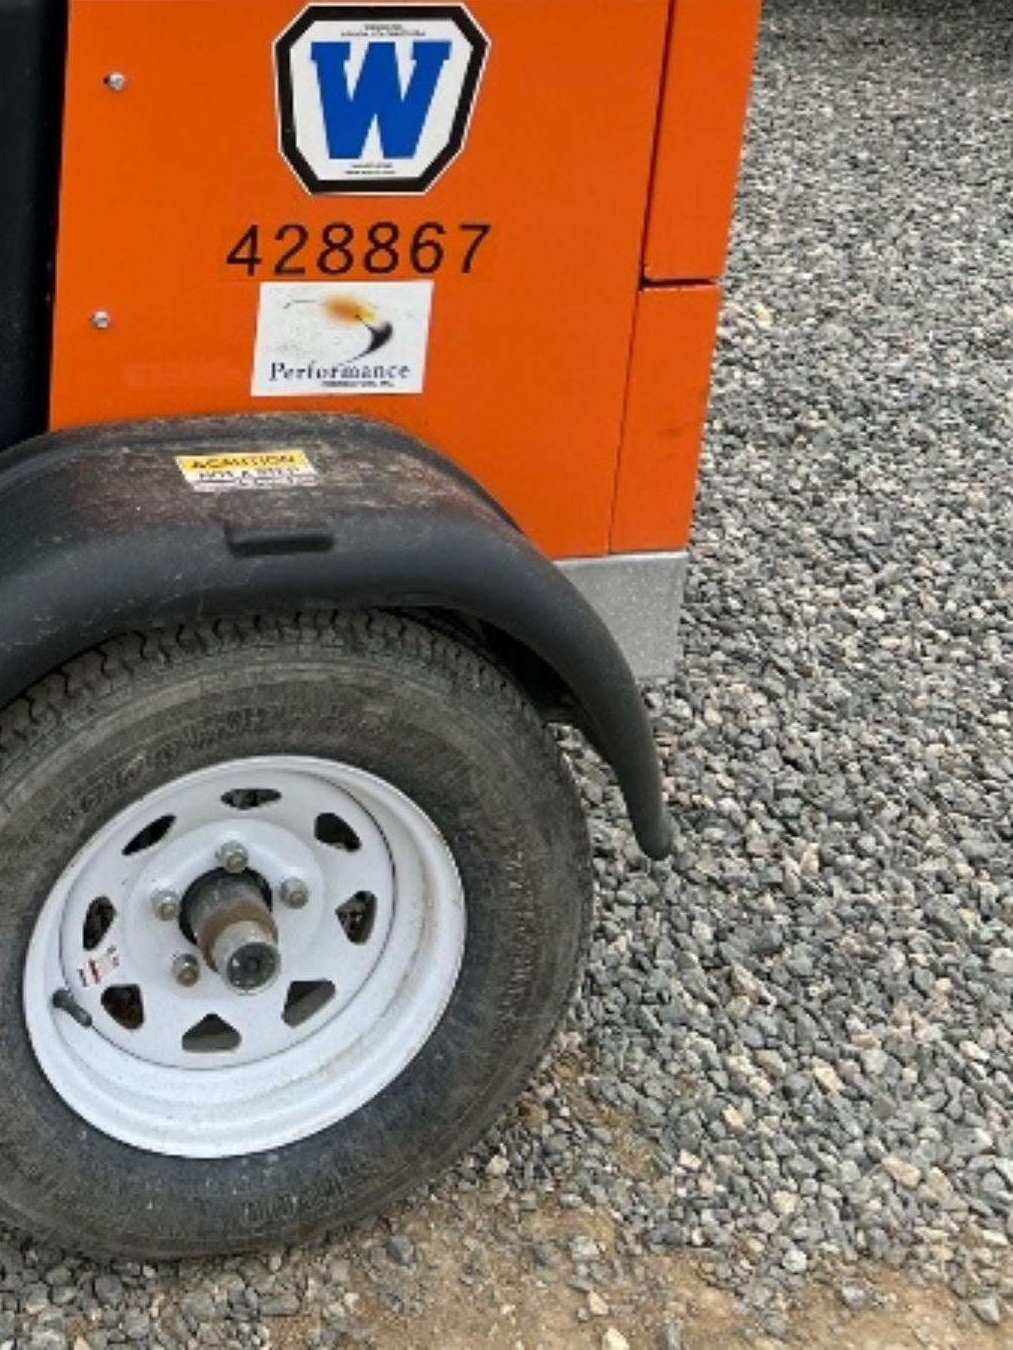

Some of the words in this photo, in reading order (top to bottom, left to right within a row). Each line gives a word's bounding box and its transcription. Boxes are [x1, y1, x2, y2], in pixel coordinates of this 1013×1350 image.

[310, 41, 452, 160] W
[226, 221, 492, 276] 428867
[267, 359, 411, 382] Performance
